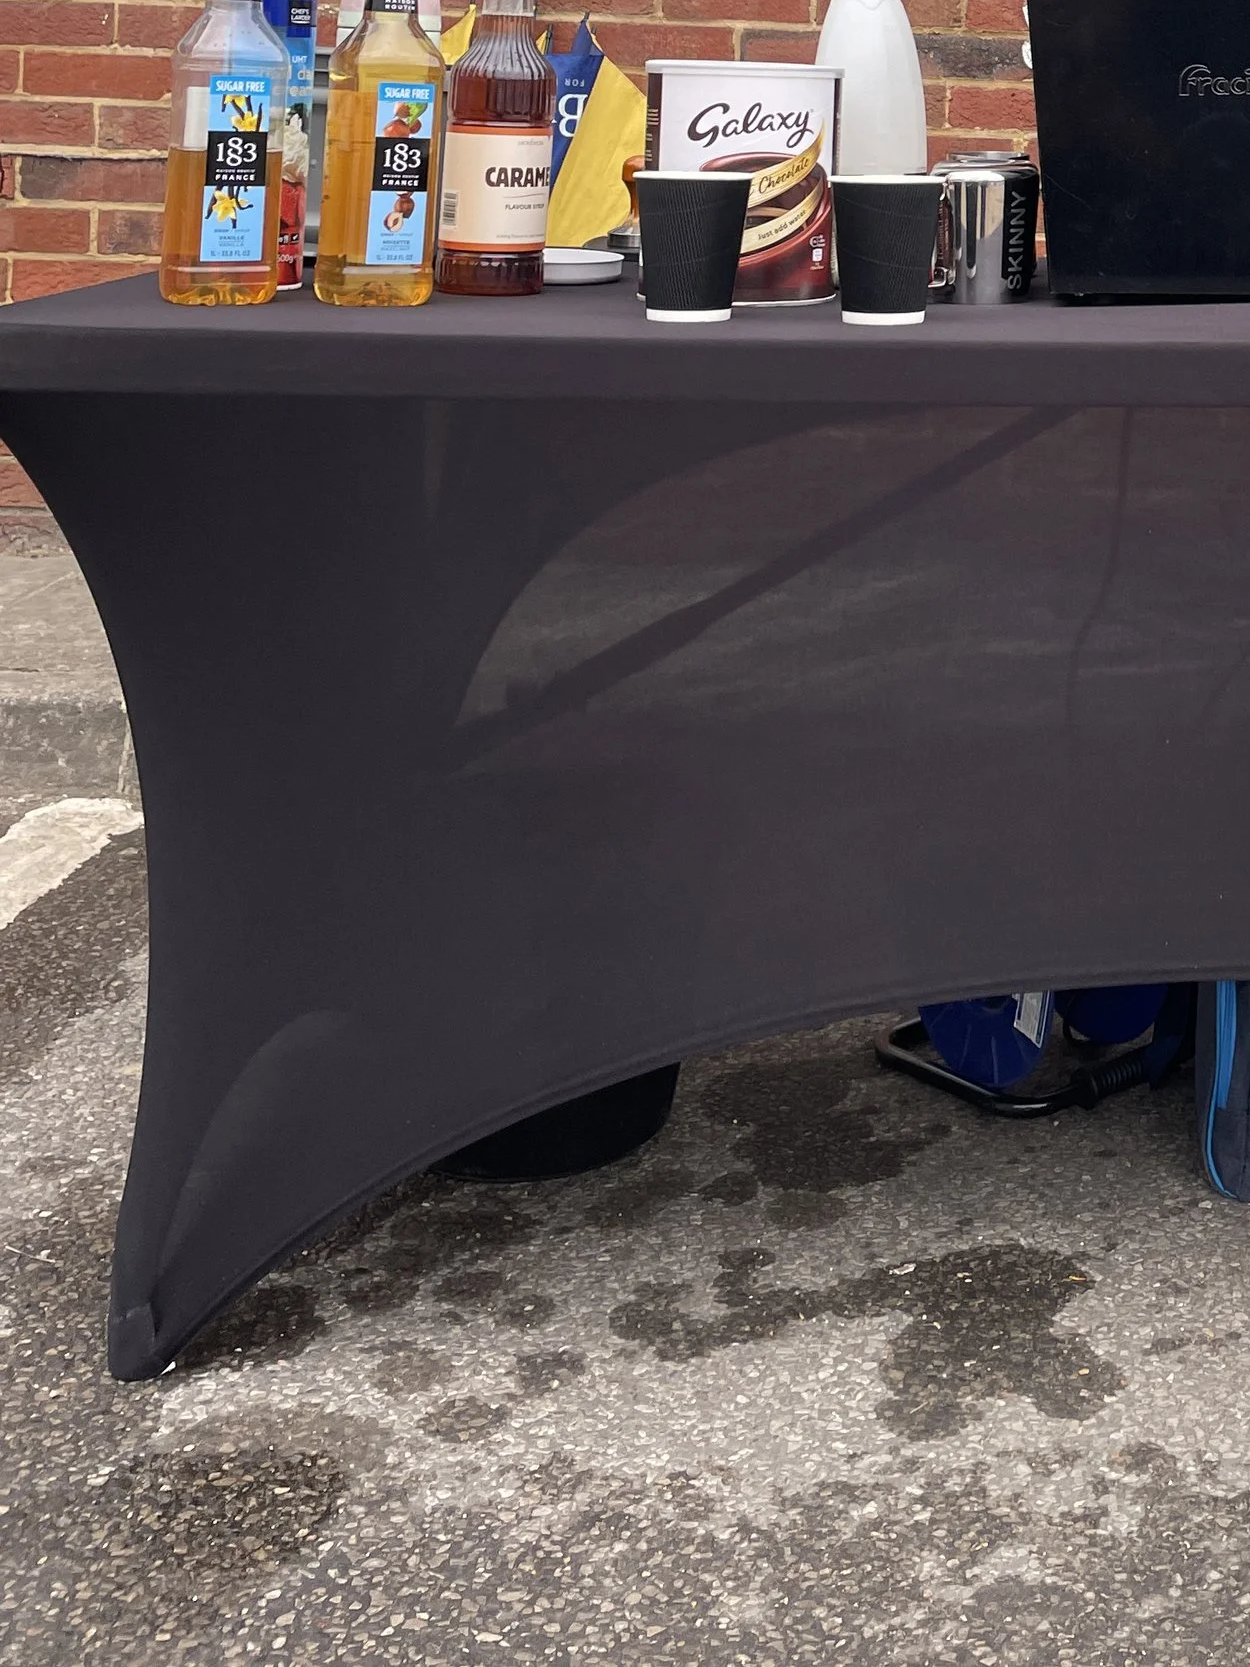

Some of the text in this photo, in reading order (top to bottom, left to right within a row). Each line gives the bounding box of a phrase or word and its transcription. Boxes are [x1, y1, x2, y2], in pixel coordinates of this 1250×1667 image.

[215, 80, 265, 93] SUGAR FREE
[384, 87, 430, 100] SUGAR FREE
[564, 78, 585, 87] FOR
[686, 102, 815, 148] Galaxy
[216, 136, 258, 167] 1883
[383, 143, 422, 172] 1883
[382, 179, 420, 187] FRANCE
[758, 156, 809, 194] Chocolate
[505, 203, 532, 211] FLAVOUR
[757, 210, 806, 241] Just add water
[1007, 191, 1027, 290] SKINNY
